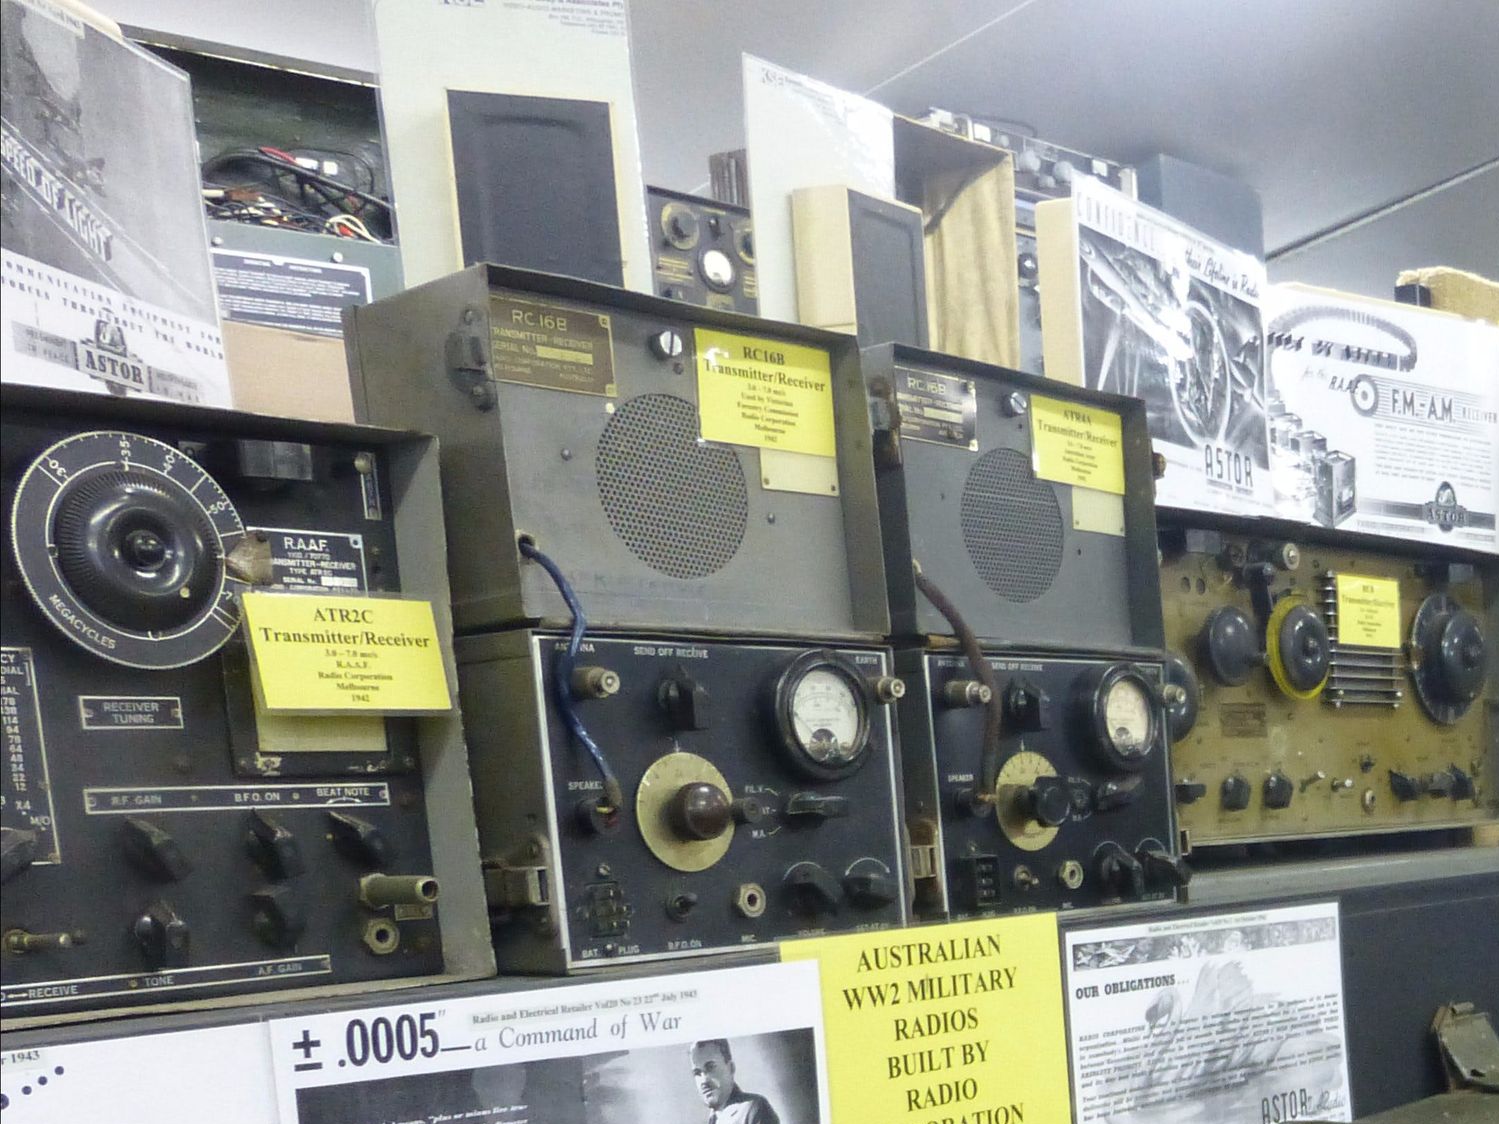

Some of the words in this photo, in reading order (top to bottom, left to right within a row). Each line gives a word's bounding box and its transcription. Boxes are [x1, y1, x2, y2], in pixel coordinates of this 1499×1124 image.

[85, 349, 144, 385] ASTOR
[743, 346, 785, 365] RC16B
[1205, 444, 1253, 488] ASTOR
[49, 594, 116, 649] MEGACYCLES
[314, 607, 374, 624] ATR2C
[259, 627, 431, 648] Transmitter/Receiver
[103, 702, 160, 713] RECEIVER
[112, 713, 155, 724] TUNING
[316, 787, 342, 798] BEAT
[344, 786, 370, 797] NOTE
[857, 934, 1001, 973] AUSTRALIAN
[29, 983, 79, 998] RECEIVE
[144, 974, 174, 988] TONE
[842, 982, 901, 1011] WW2
[908, 966, 1017, 1004] MILITARY
[1075, 986, 1100, 999] OUR
[499, 1017, 599, 1049] Command
[610, 1014, 629, 1040] of
[640, 1011, 682, 1032] War
[894, 1007, 979, 1042] RADIOS
[10, 1050, 41, 1064] 1943
[887, 1046, 955, 1080] BUILT
[962, 1040, 990, 1066] BY
[906, 1078, 978, 1112] RADIO
